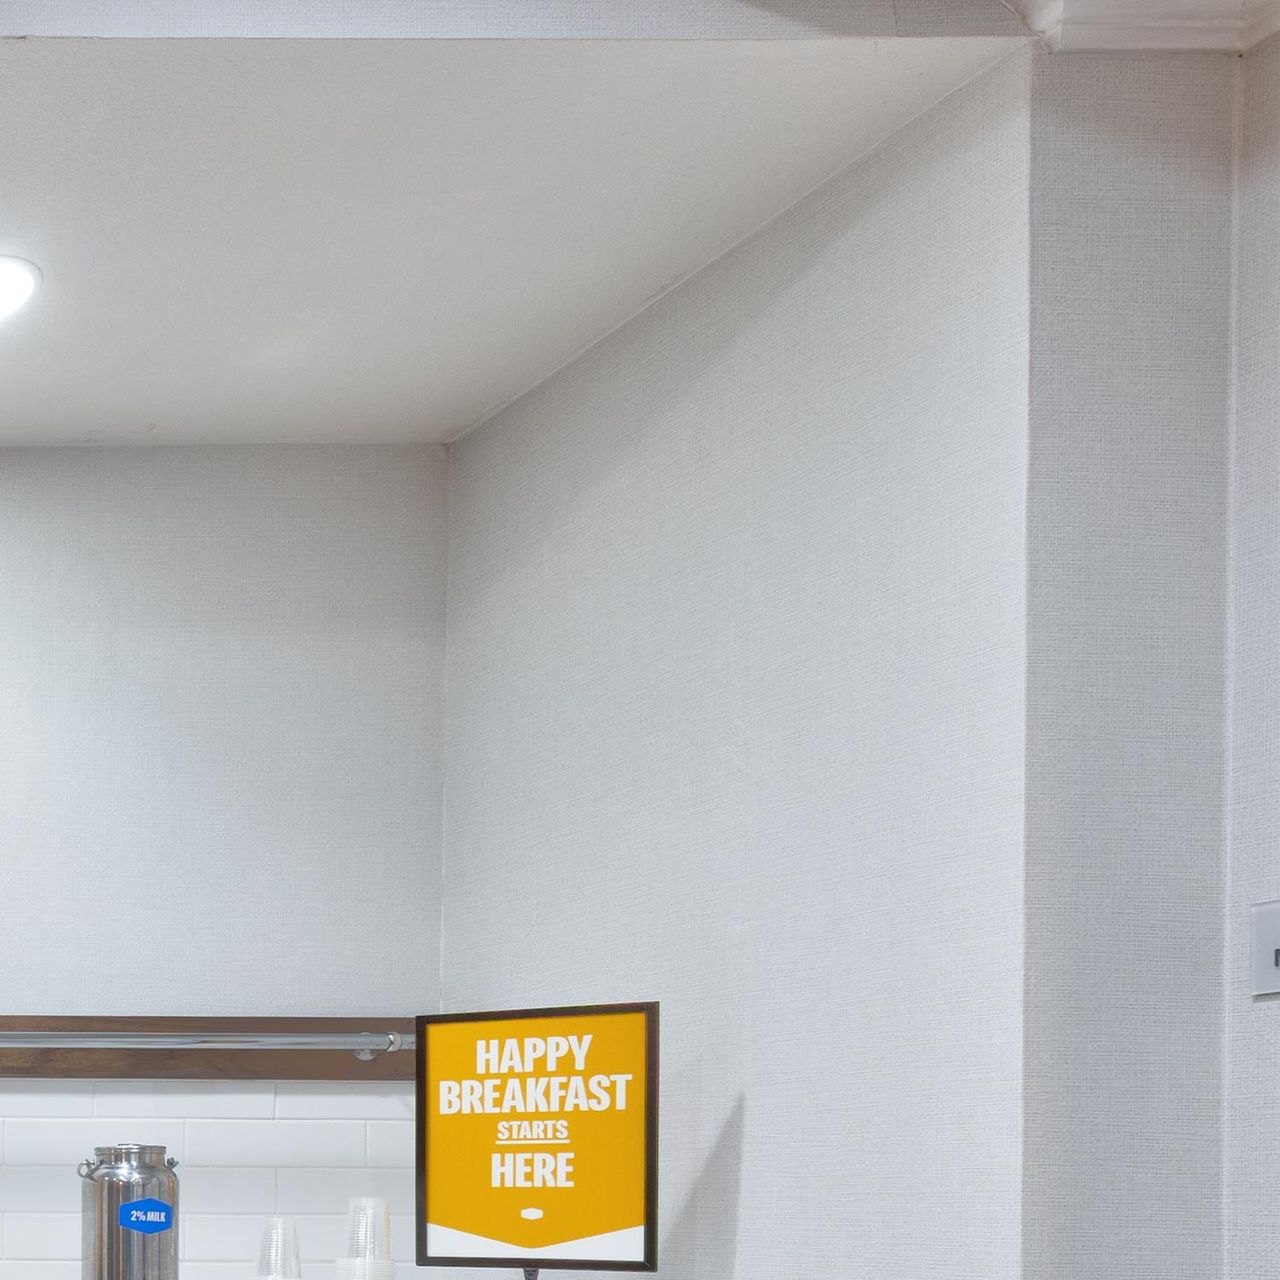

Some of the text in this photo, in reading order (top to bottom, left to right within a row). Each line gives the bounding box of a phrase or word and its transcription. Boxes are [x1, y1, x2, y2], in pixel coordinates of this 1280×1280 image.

[476, 1034, 593, 1075] HAPPY
[439, 1074, 633, 1115] BREAKFAST
[496, 1120, 569, 1140] STARTS
[491, 1152, 575, 1188] HERE
[130, 1210, 166, 1223] 2% MILK
